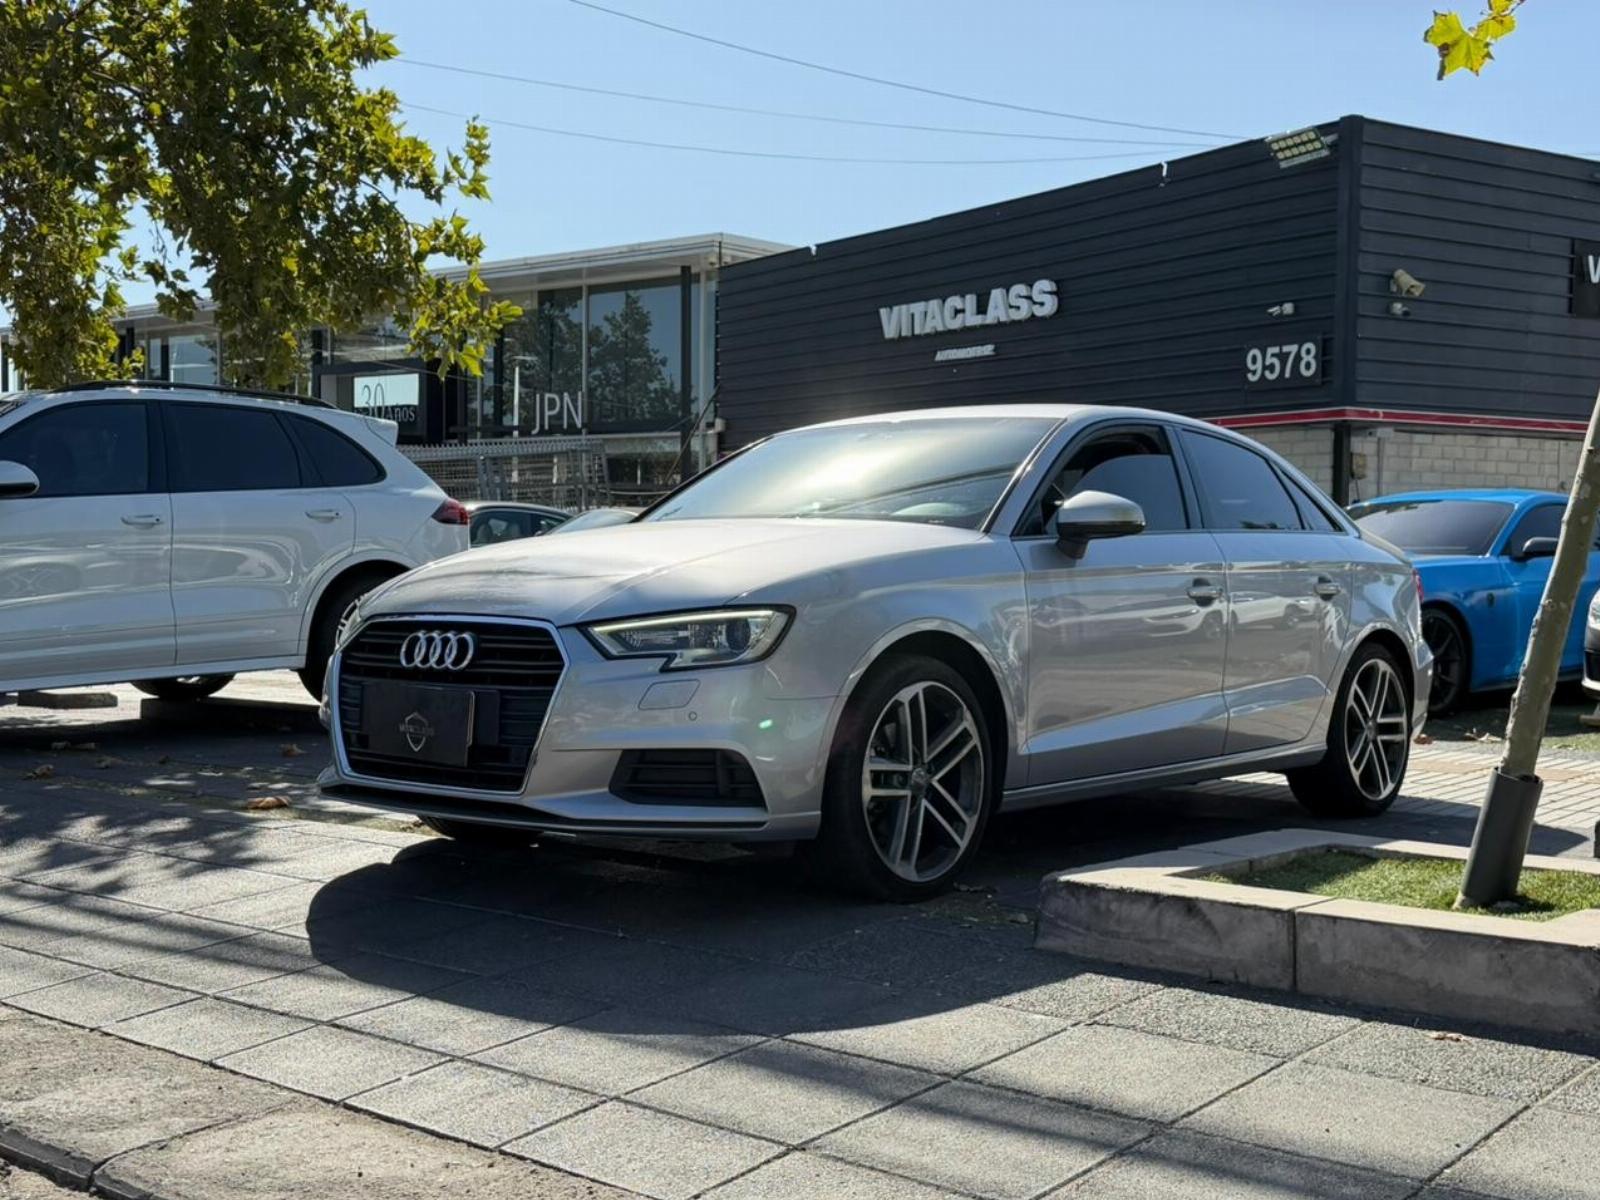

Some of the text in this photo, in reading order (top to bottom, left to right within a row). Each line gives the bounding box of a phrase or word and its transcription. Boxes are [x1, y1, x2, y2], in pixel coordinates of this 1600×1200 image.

[879, 278, 1058, 339] VITACLASS
[1246, 342, 1317, 382] 9578
[531, 391, 582, 435] JPN
